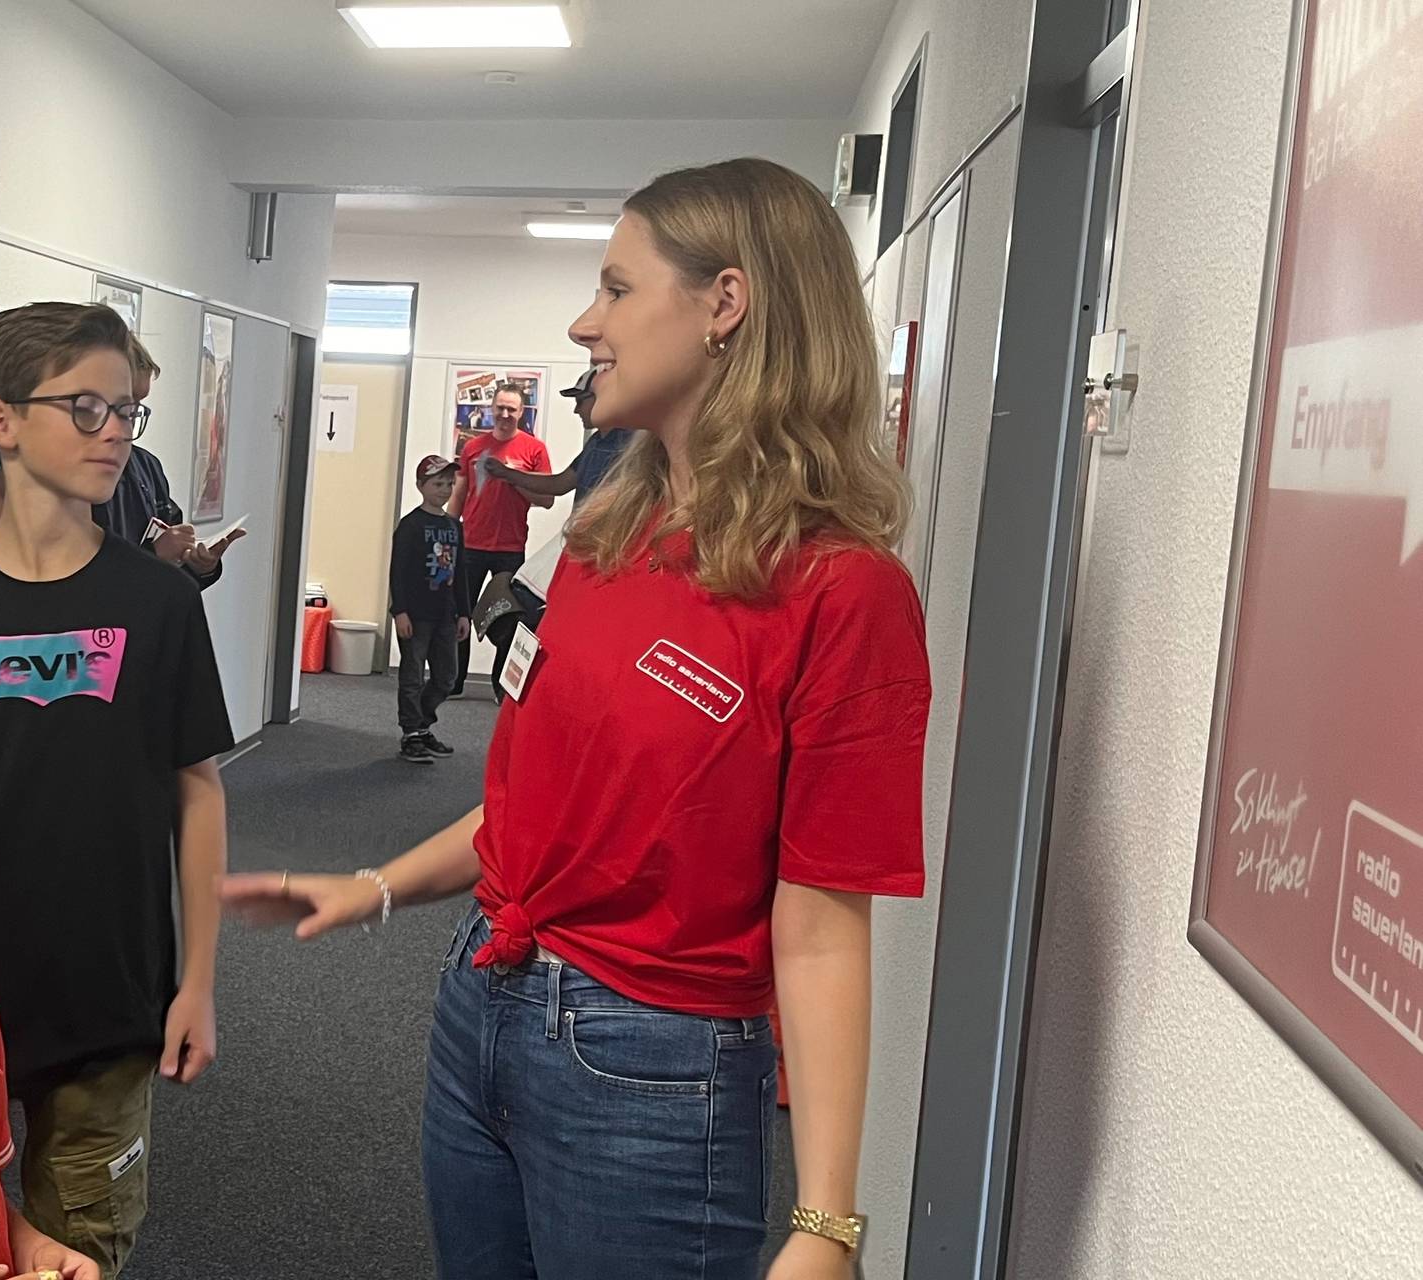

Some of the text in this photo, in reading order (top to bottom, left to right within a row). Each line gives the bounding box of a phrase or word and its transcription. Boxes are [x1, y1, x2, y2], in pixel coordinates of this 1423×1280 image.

[653, 651, 733, 704] radio sauerland
[1229, 767, 1308, 856] So klingt
[1356, 849, 1401, 899] radio
[1351, 895, 1423, 970] sauerlan
